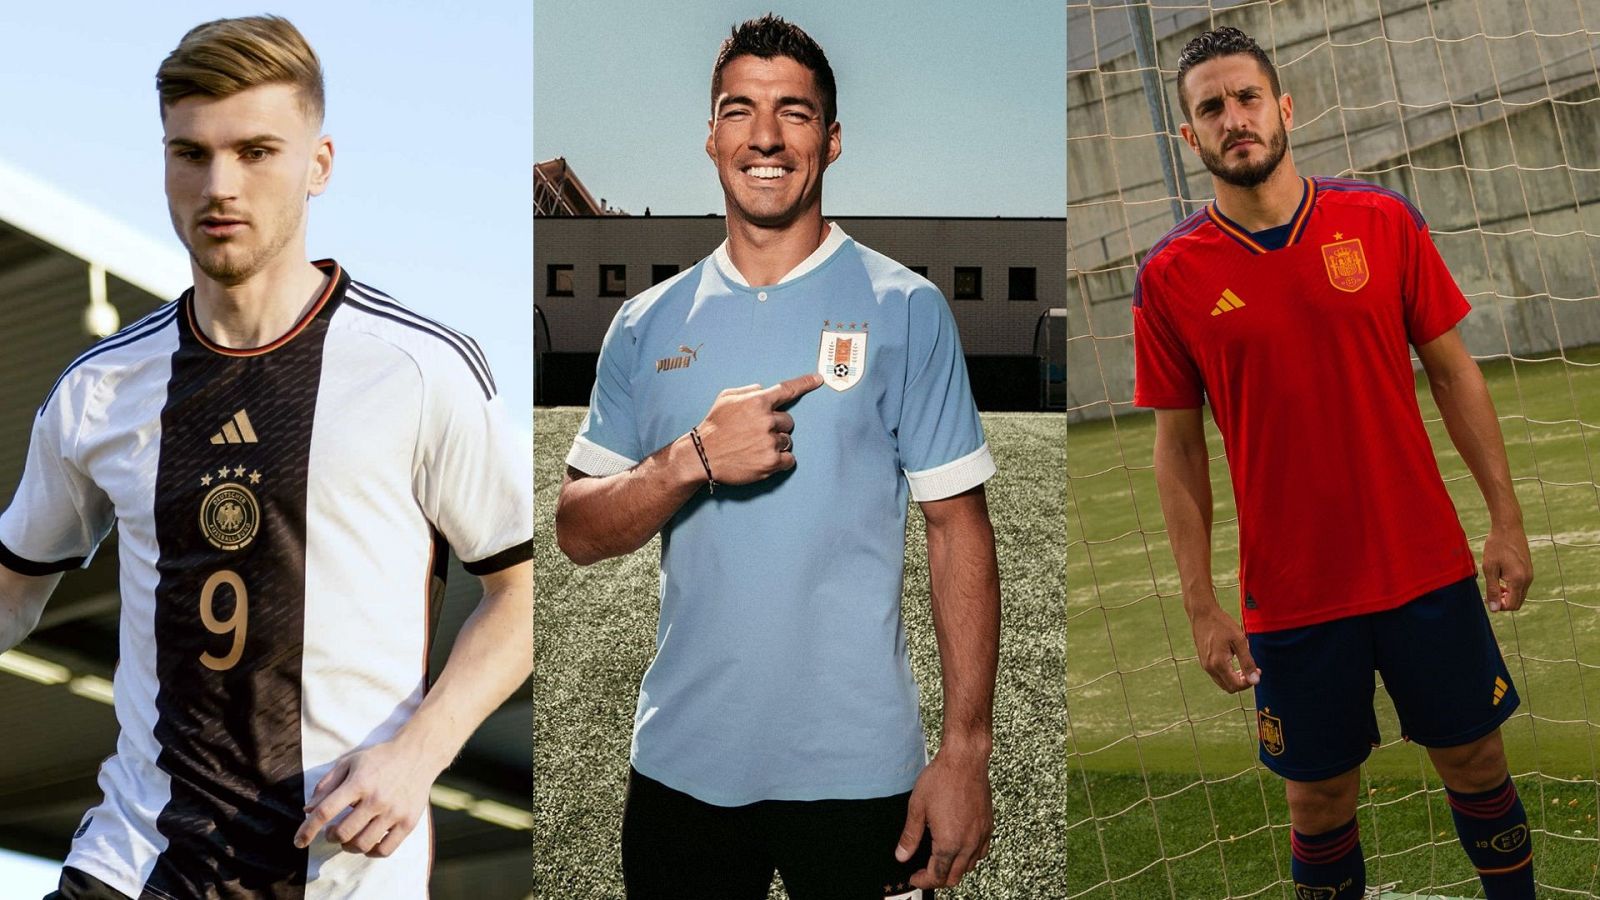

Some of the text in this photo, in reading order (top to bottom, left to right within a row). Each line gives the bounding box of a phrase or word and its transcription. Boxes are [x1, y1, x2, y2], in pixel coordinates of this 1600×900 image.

[656, 356, 691, 373] PUMA
[213, 492, 247, 506] DEUTSCHER
[200, 570, 248, 671] 9
